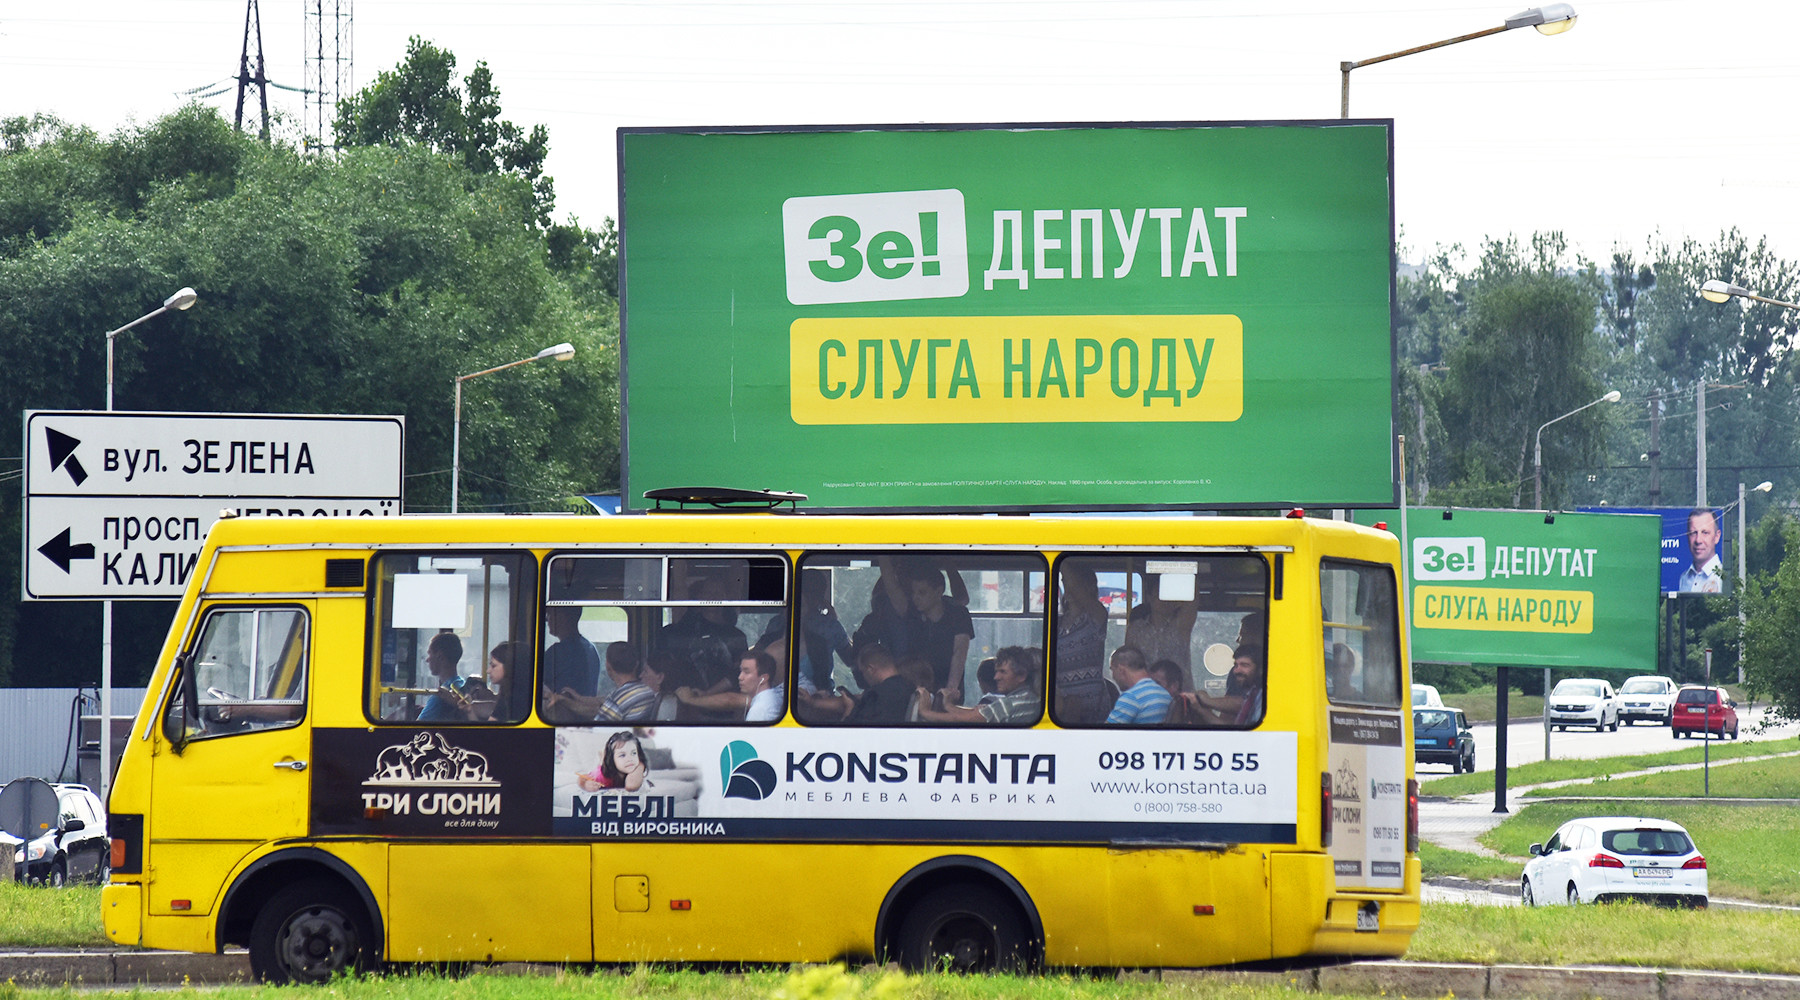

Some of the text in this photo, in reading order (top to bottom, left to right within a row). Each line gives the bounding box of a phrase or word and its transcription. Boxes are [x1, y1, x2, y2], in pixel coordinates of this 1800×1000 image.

[807, 207, 1247, 290] Зе! ДЕПУТАТ
[818, 337, 1215, 407] СЛУГА НАРОДУ
[103, 439, 315, 482] вул. ЗЕЛЕНА
[103, 516, 207, 549] просп.
[1422, 545, 1598, 578] Зе! ДЕПУТАТ
[1425, 594, 1582, 627] СЛУГА НАРОДУ
[786, 752, 1056, 785] KONSTANTA
[1099, 751, 1259, 772] 098 171 50 55
[785, 791, 1056, 805] МЕБЛЕВА ФАБРИКА
[1090, 778, 1267, 796] www.konstanta.ua
[361, 793, 501, 815] ТРИ СЛОНИ
[570, 795, 675, 818] МЕБЛІ
[1134, 802, 1223, 814] 0 (800) 758-580
[444, 820, 499, 831] все для дому
[591, 822, 725, 836] ВІД ВИРОБНИКА
